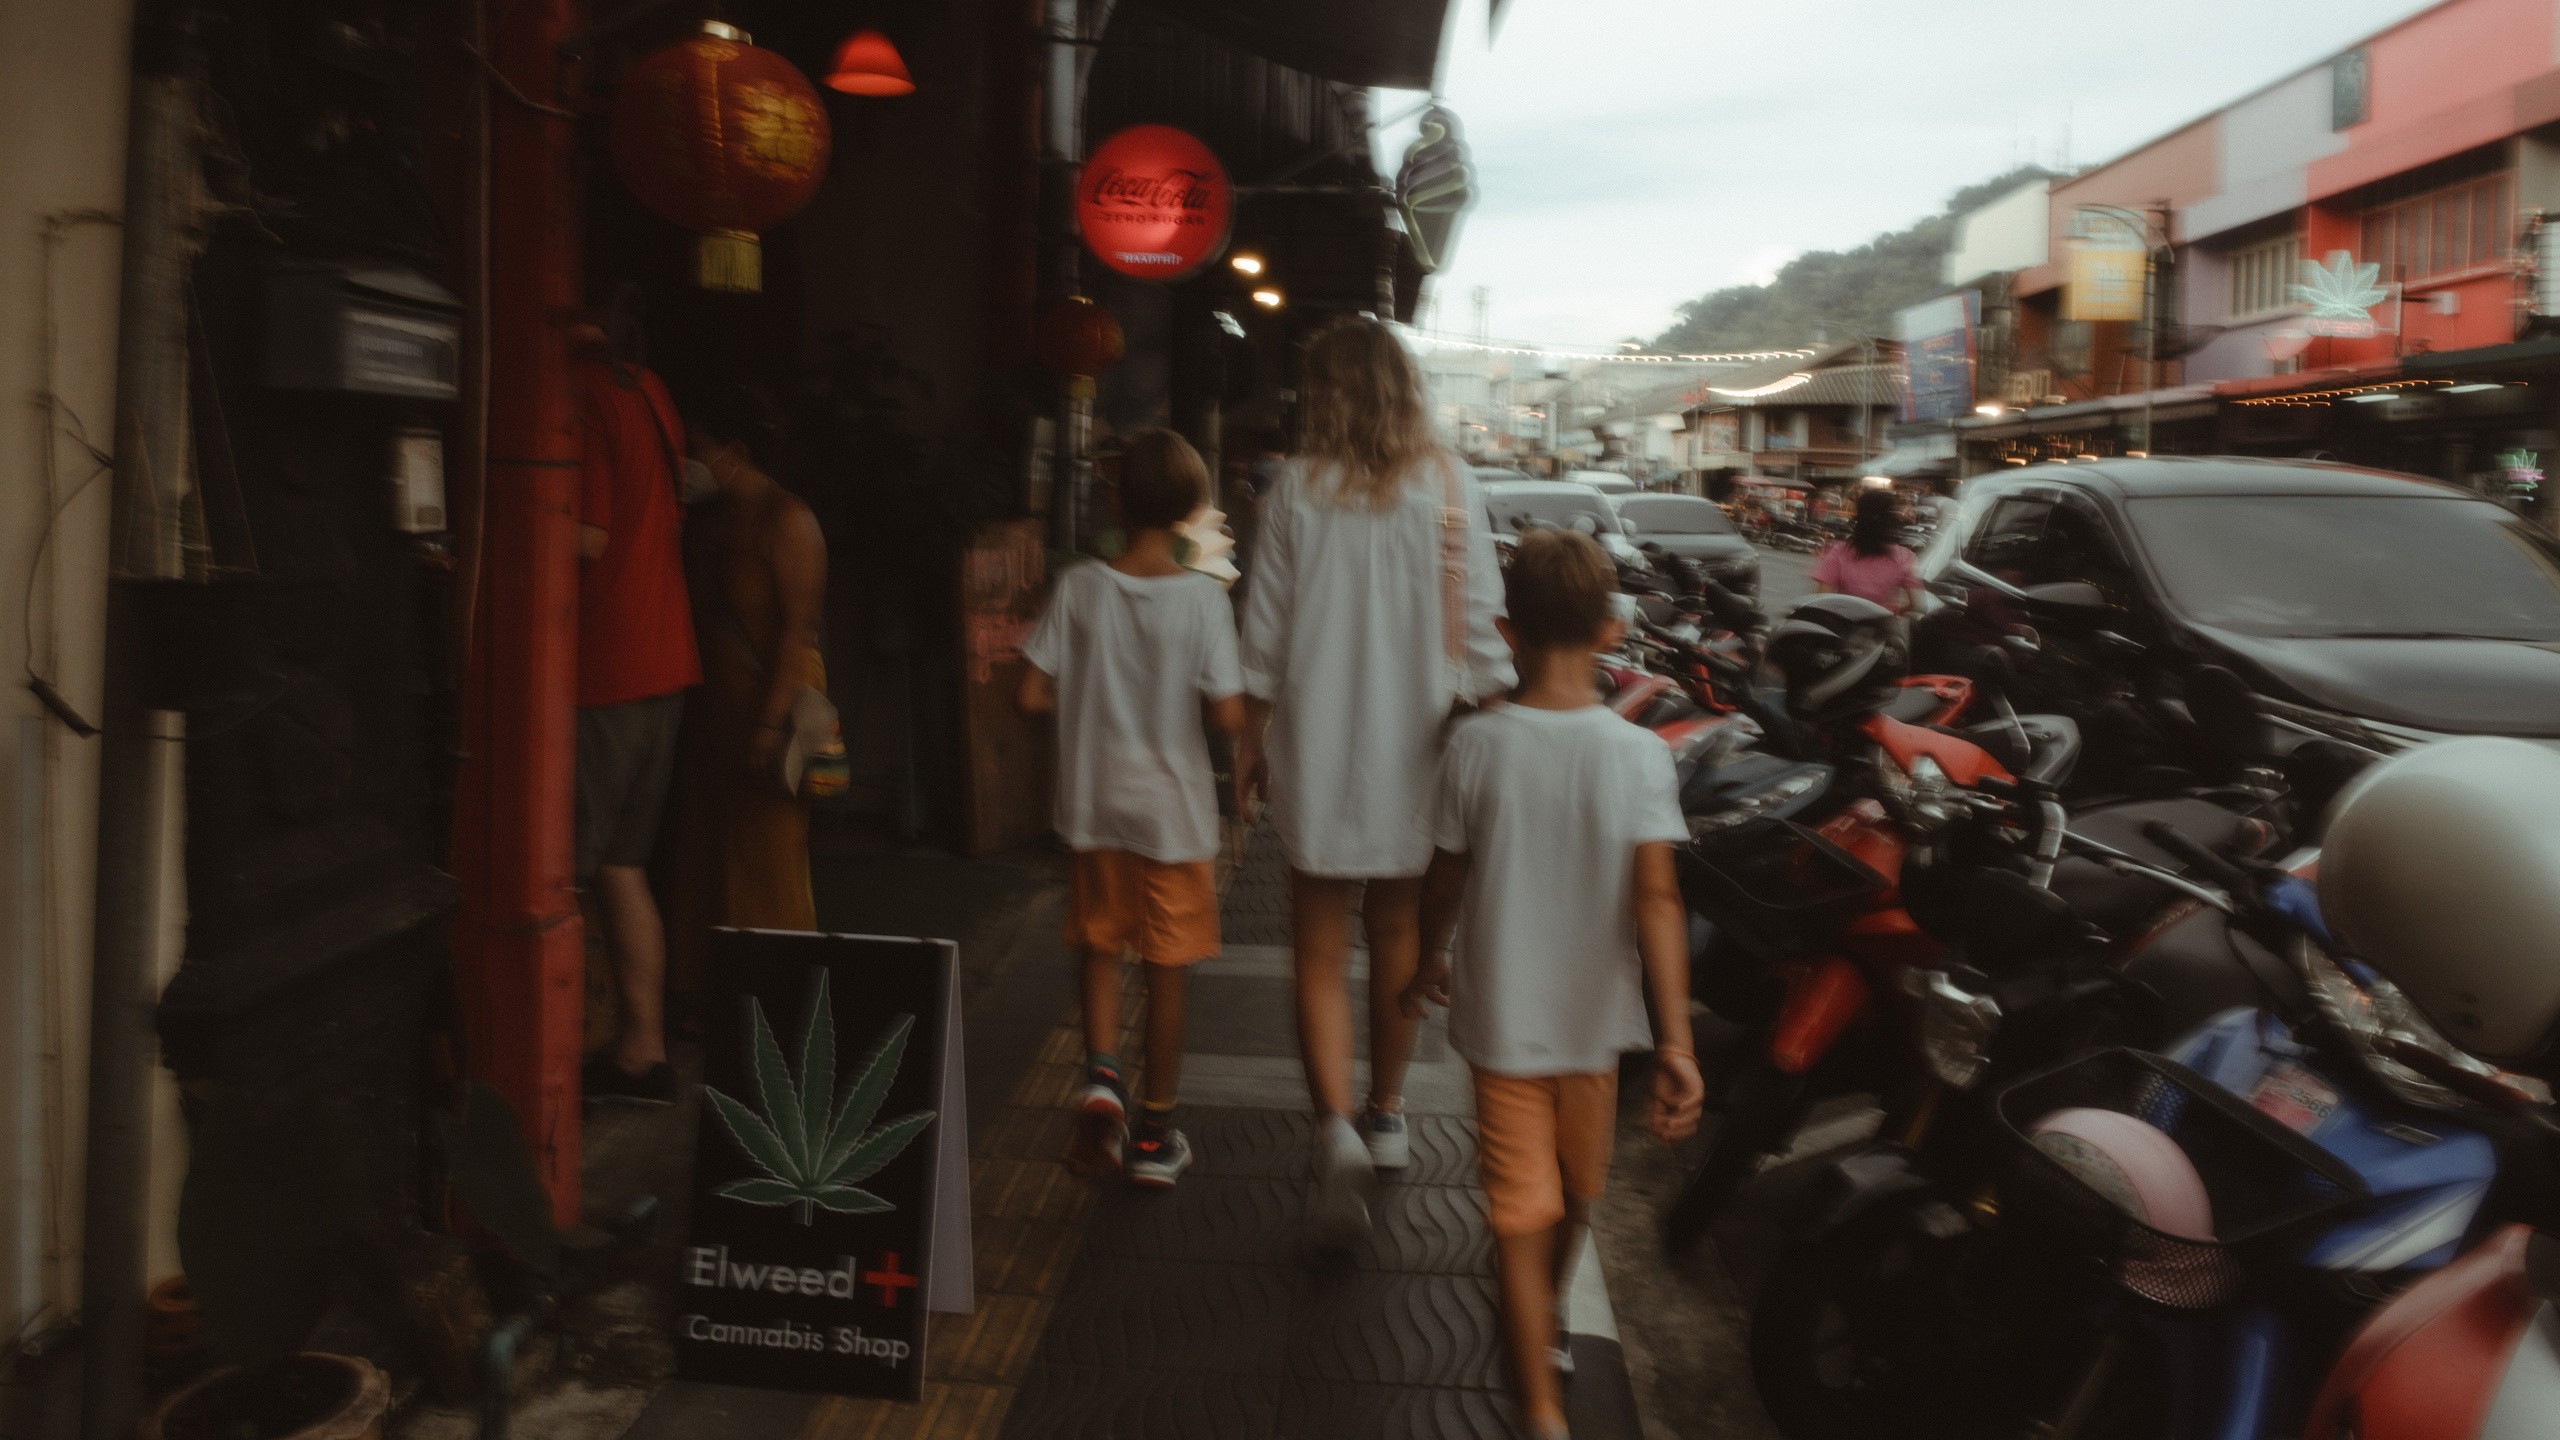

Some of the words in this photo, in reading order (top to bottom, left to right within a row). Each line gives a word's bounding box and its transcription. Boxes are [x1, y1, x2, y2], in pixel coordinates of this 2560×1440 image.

[692, 1244, 857, 1300] Elweed
[688, 1314, 825, 1351] Cannabis
[836, 1326, 911, 1369] Shop
